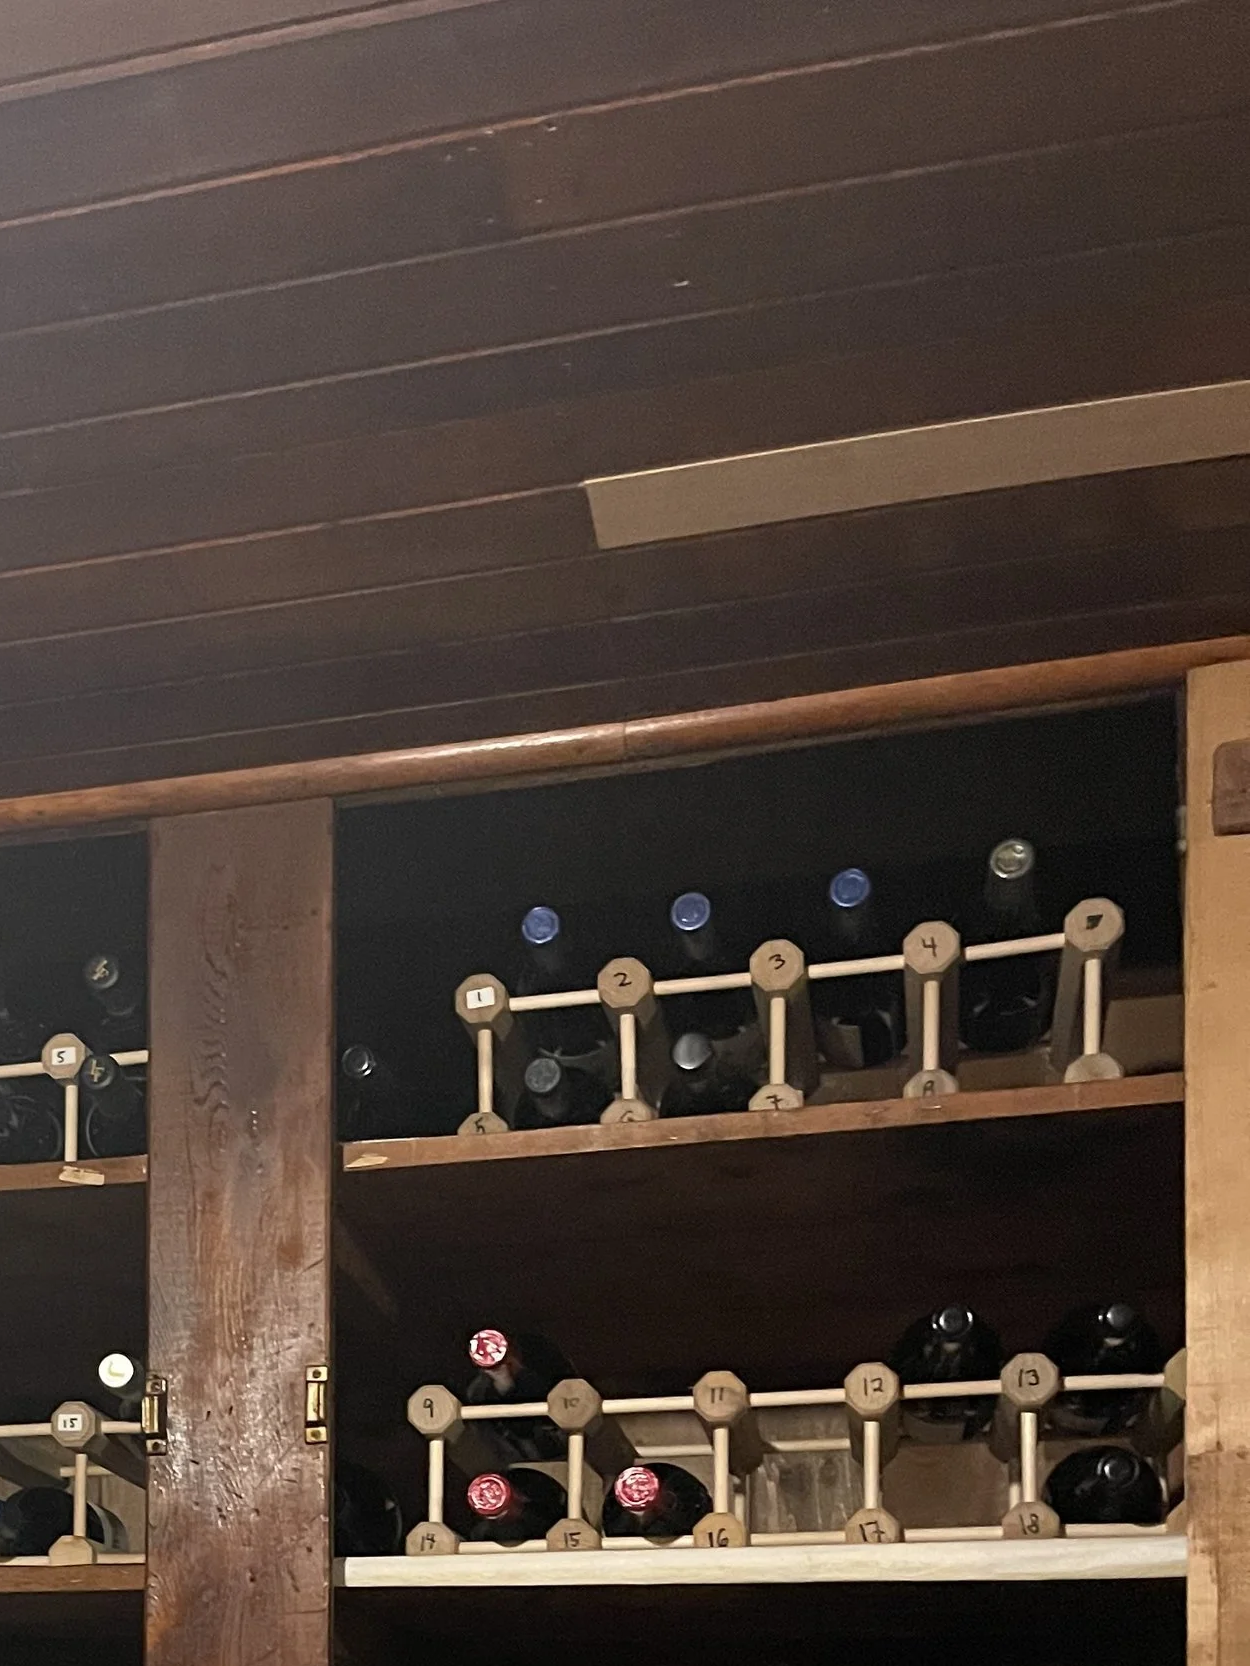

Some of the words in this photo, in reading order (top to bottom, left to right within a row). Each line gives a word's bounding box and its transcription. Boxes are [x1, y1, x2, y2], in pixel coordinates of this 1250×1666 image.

[922, 936, 937, 958] 4
[768, 953, 785, 970] 3
[613, 972, 632, 987] 2
[56, 1051, 67, 1063] 5
[1017, 1367, 1040, 1387] 13
[710, 1387, 725, 1404] 11
[863, 1377, 884, 1396] 12
[423, 1398, 434, 1418] 9
[62, 1417, 78, 1429] 15
[859, 1520, 886, 1543] 17
[1019, 1513, 1040, 1536] 18
[419, 1535, 436, 1551] 14
[563, 1531, 581, 1547] 15
[706, 1528, 729, 1548] 16
